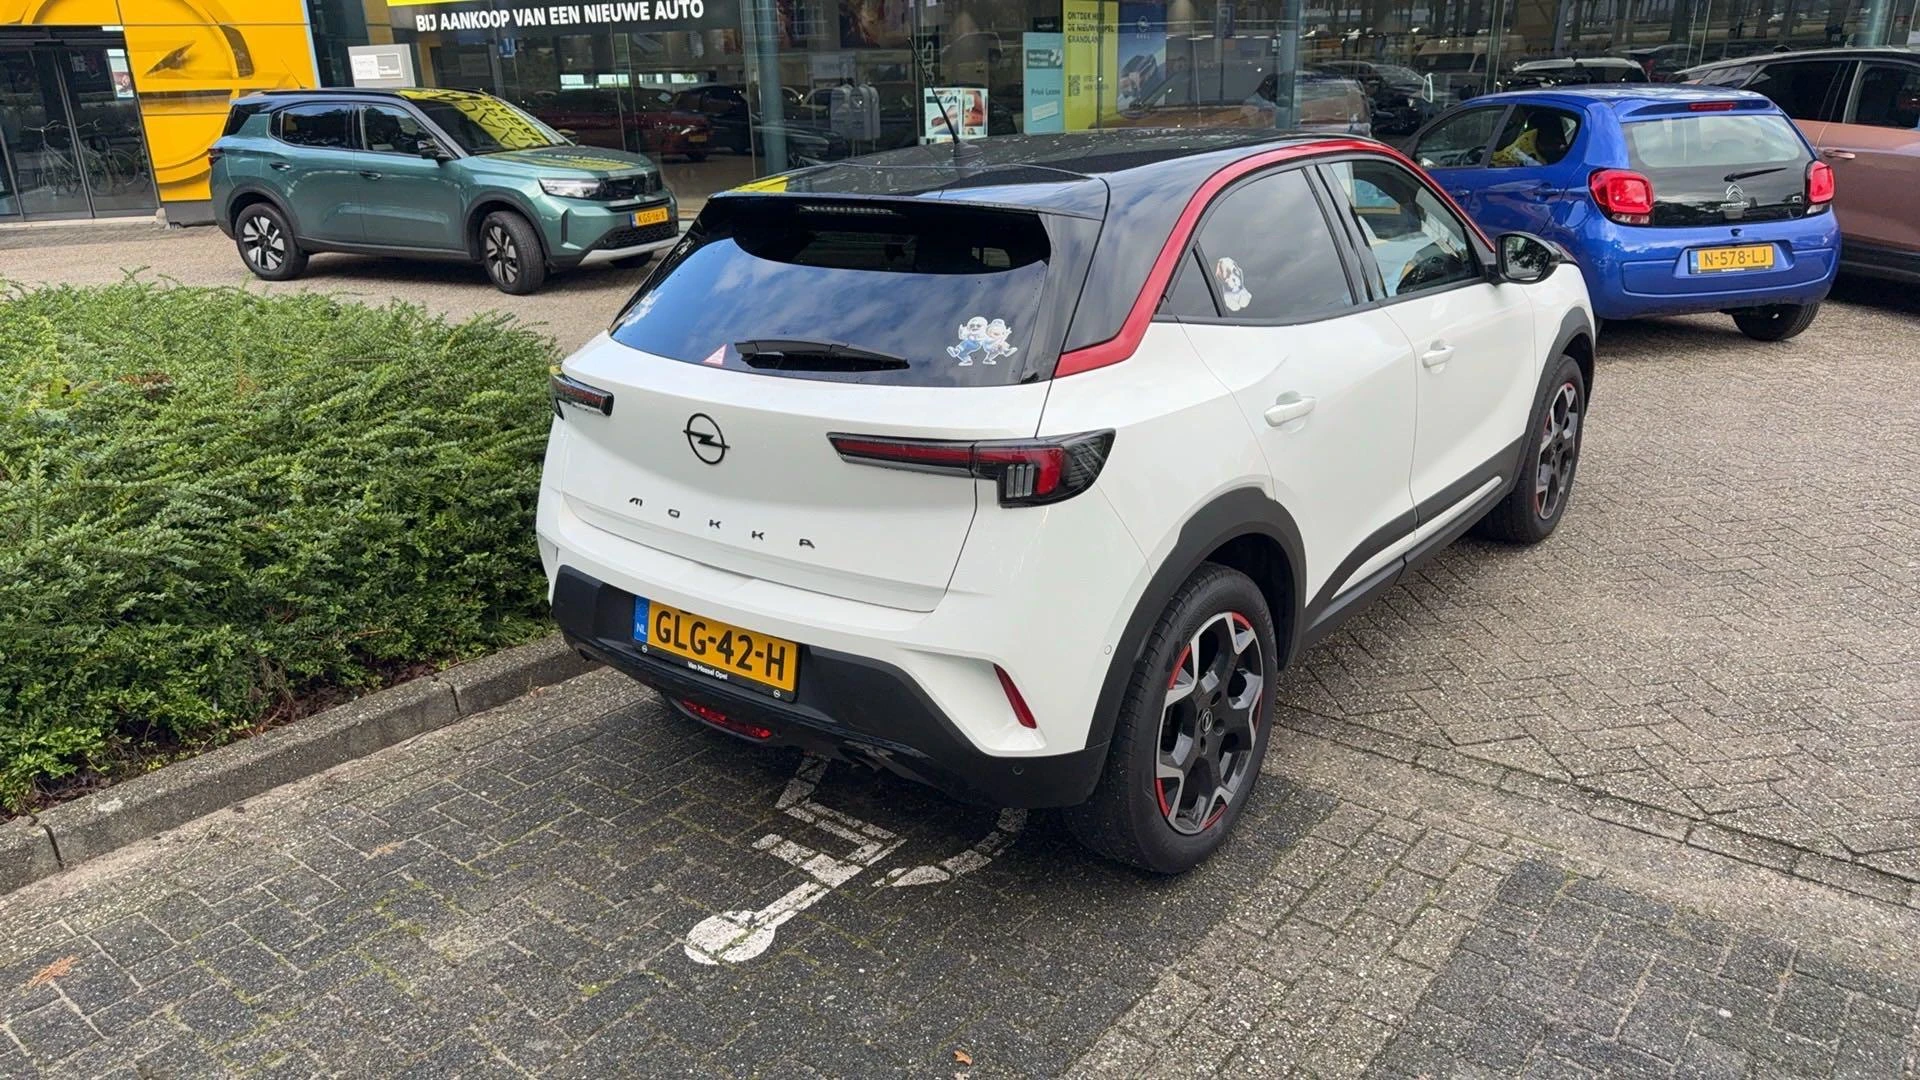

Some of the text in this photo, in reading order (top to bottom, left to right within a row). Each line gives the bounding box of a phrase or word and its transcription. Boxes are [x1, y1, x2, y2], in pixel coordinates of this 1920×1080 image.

[416, 0, 705, 32] BIJ AANKOOP VAN EEN NIEUWE AUTO
[1704, 249, 1767, 267] N-578-LJ
[629, 497, 816, 549] MOKKA
[636, 610, 786, 681] NL GLG-42-H
